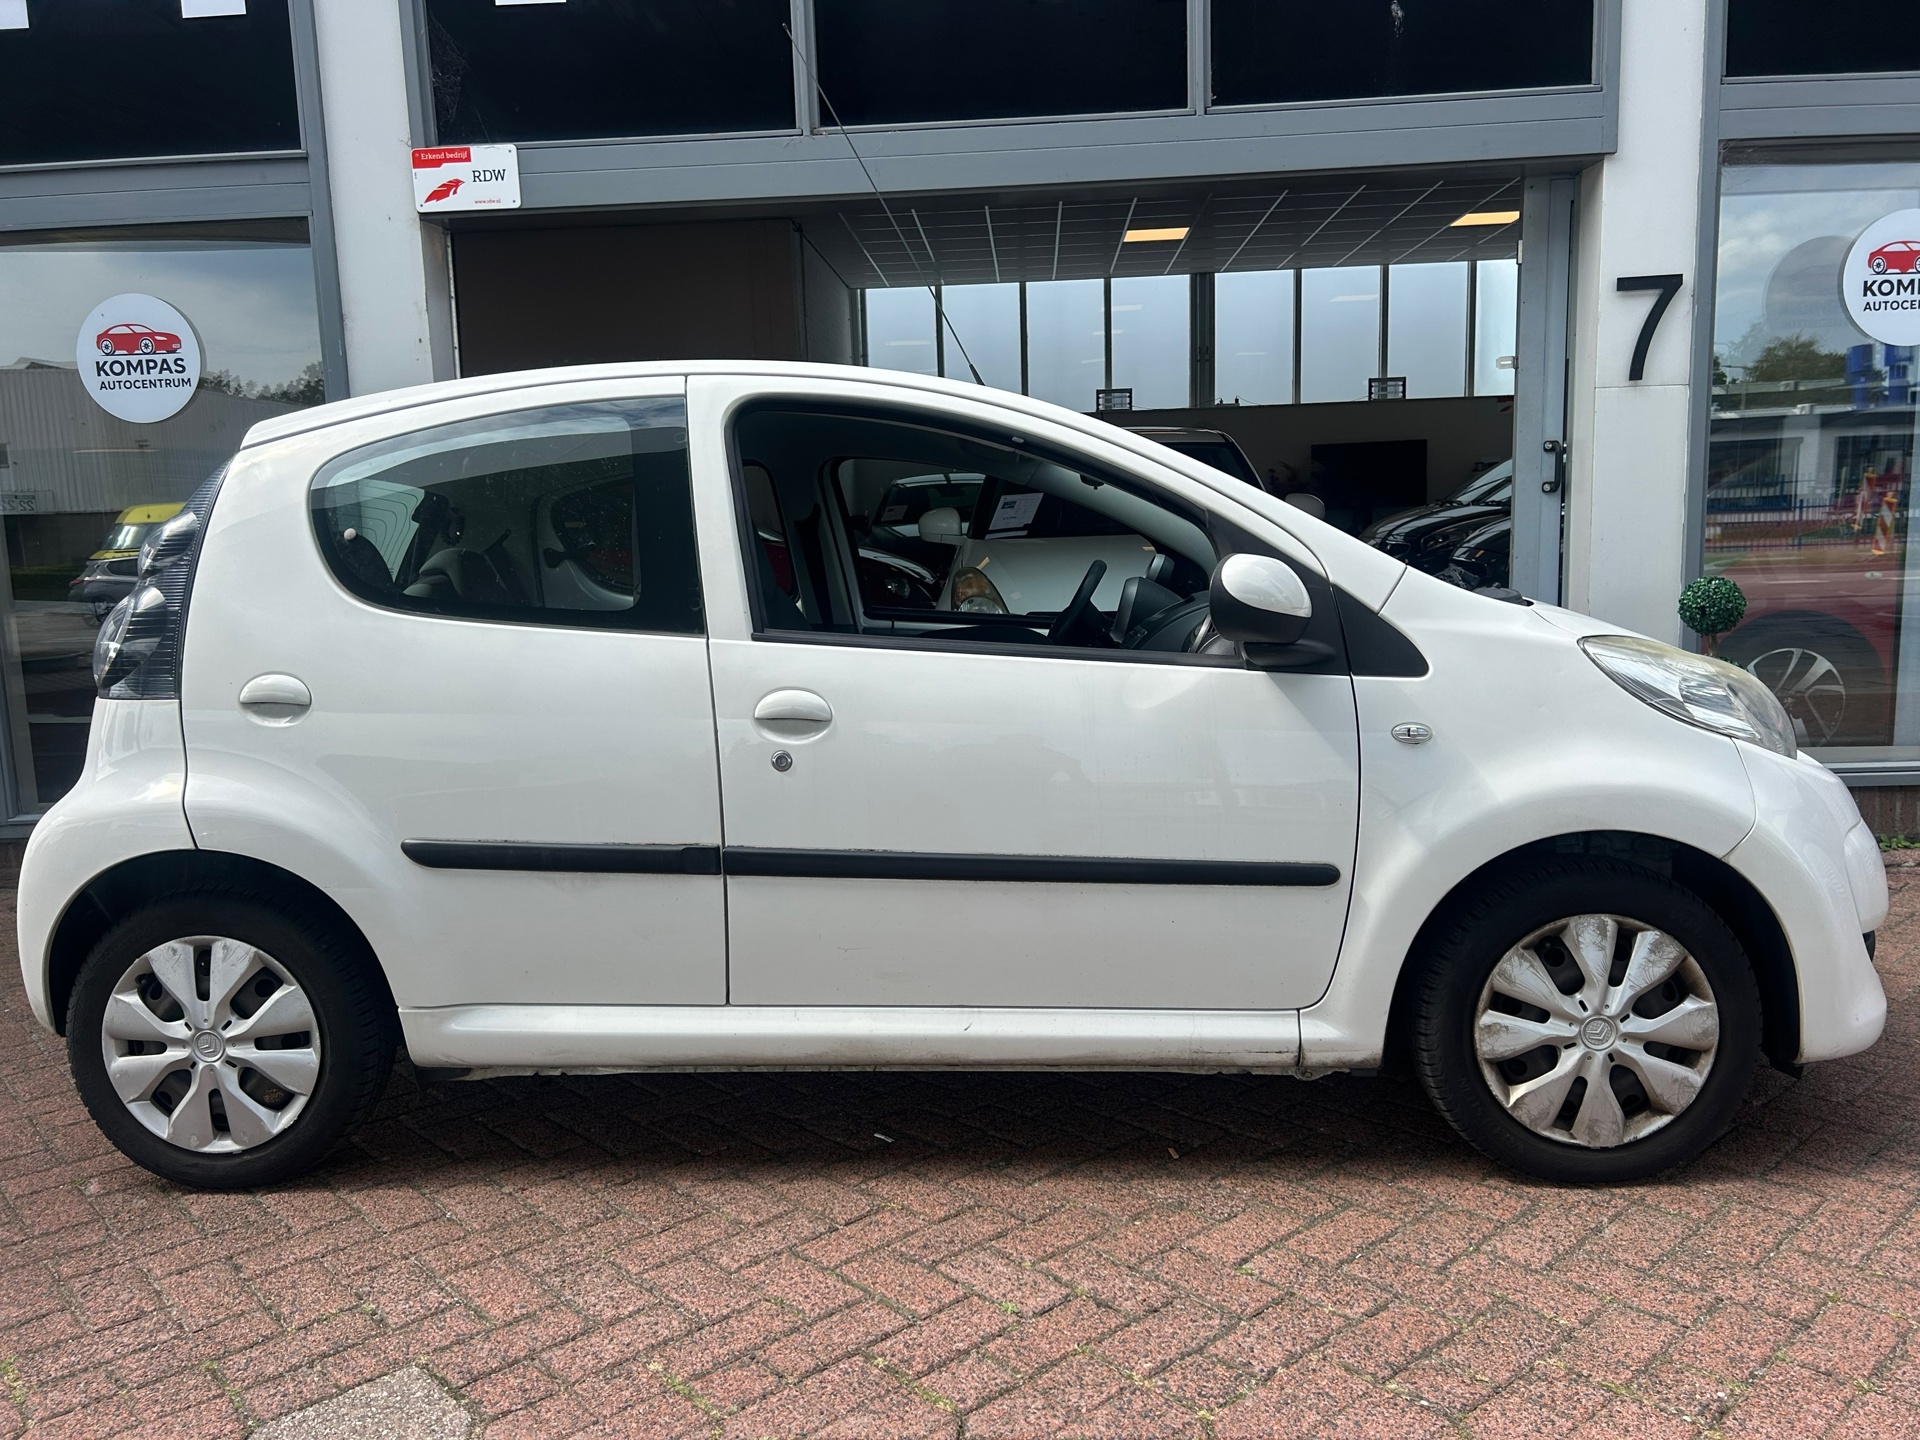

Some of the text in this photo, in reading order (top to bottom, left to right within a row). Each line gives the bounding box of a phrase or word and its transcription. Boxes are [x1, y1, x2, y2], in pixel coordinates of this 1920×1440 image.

[421, 151, 468, 160] Erkend bedrijf
[472, 168, 506, 182] RDW
[1863, 300, 1920, 312] AUTOCE
[1616, 273, 1684, 381] 7
[95, 358, 186, 377] KOMPAS
[99, 377, 192, 391] AUTOCENTRUM
